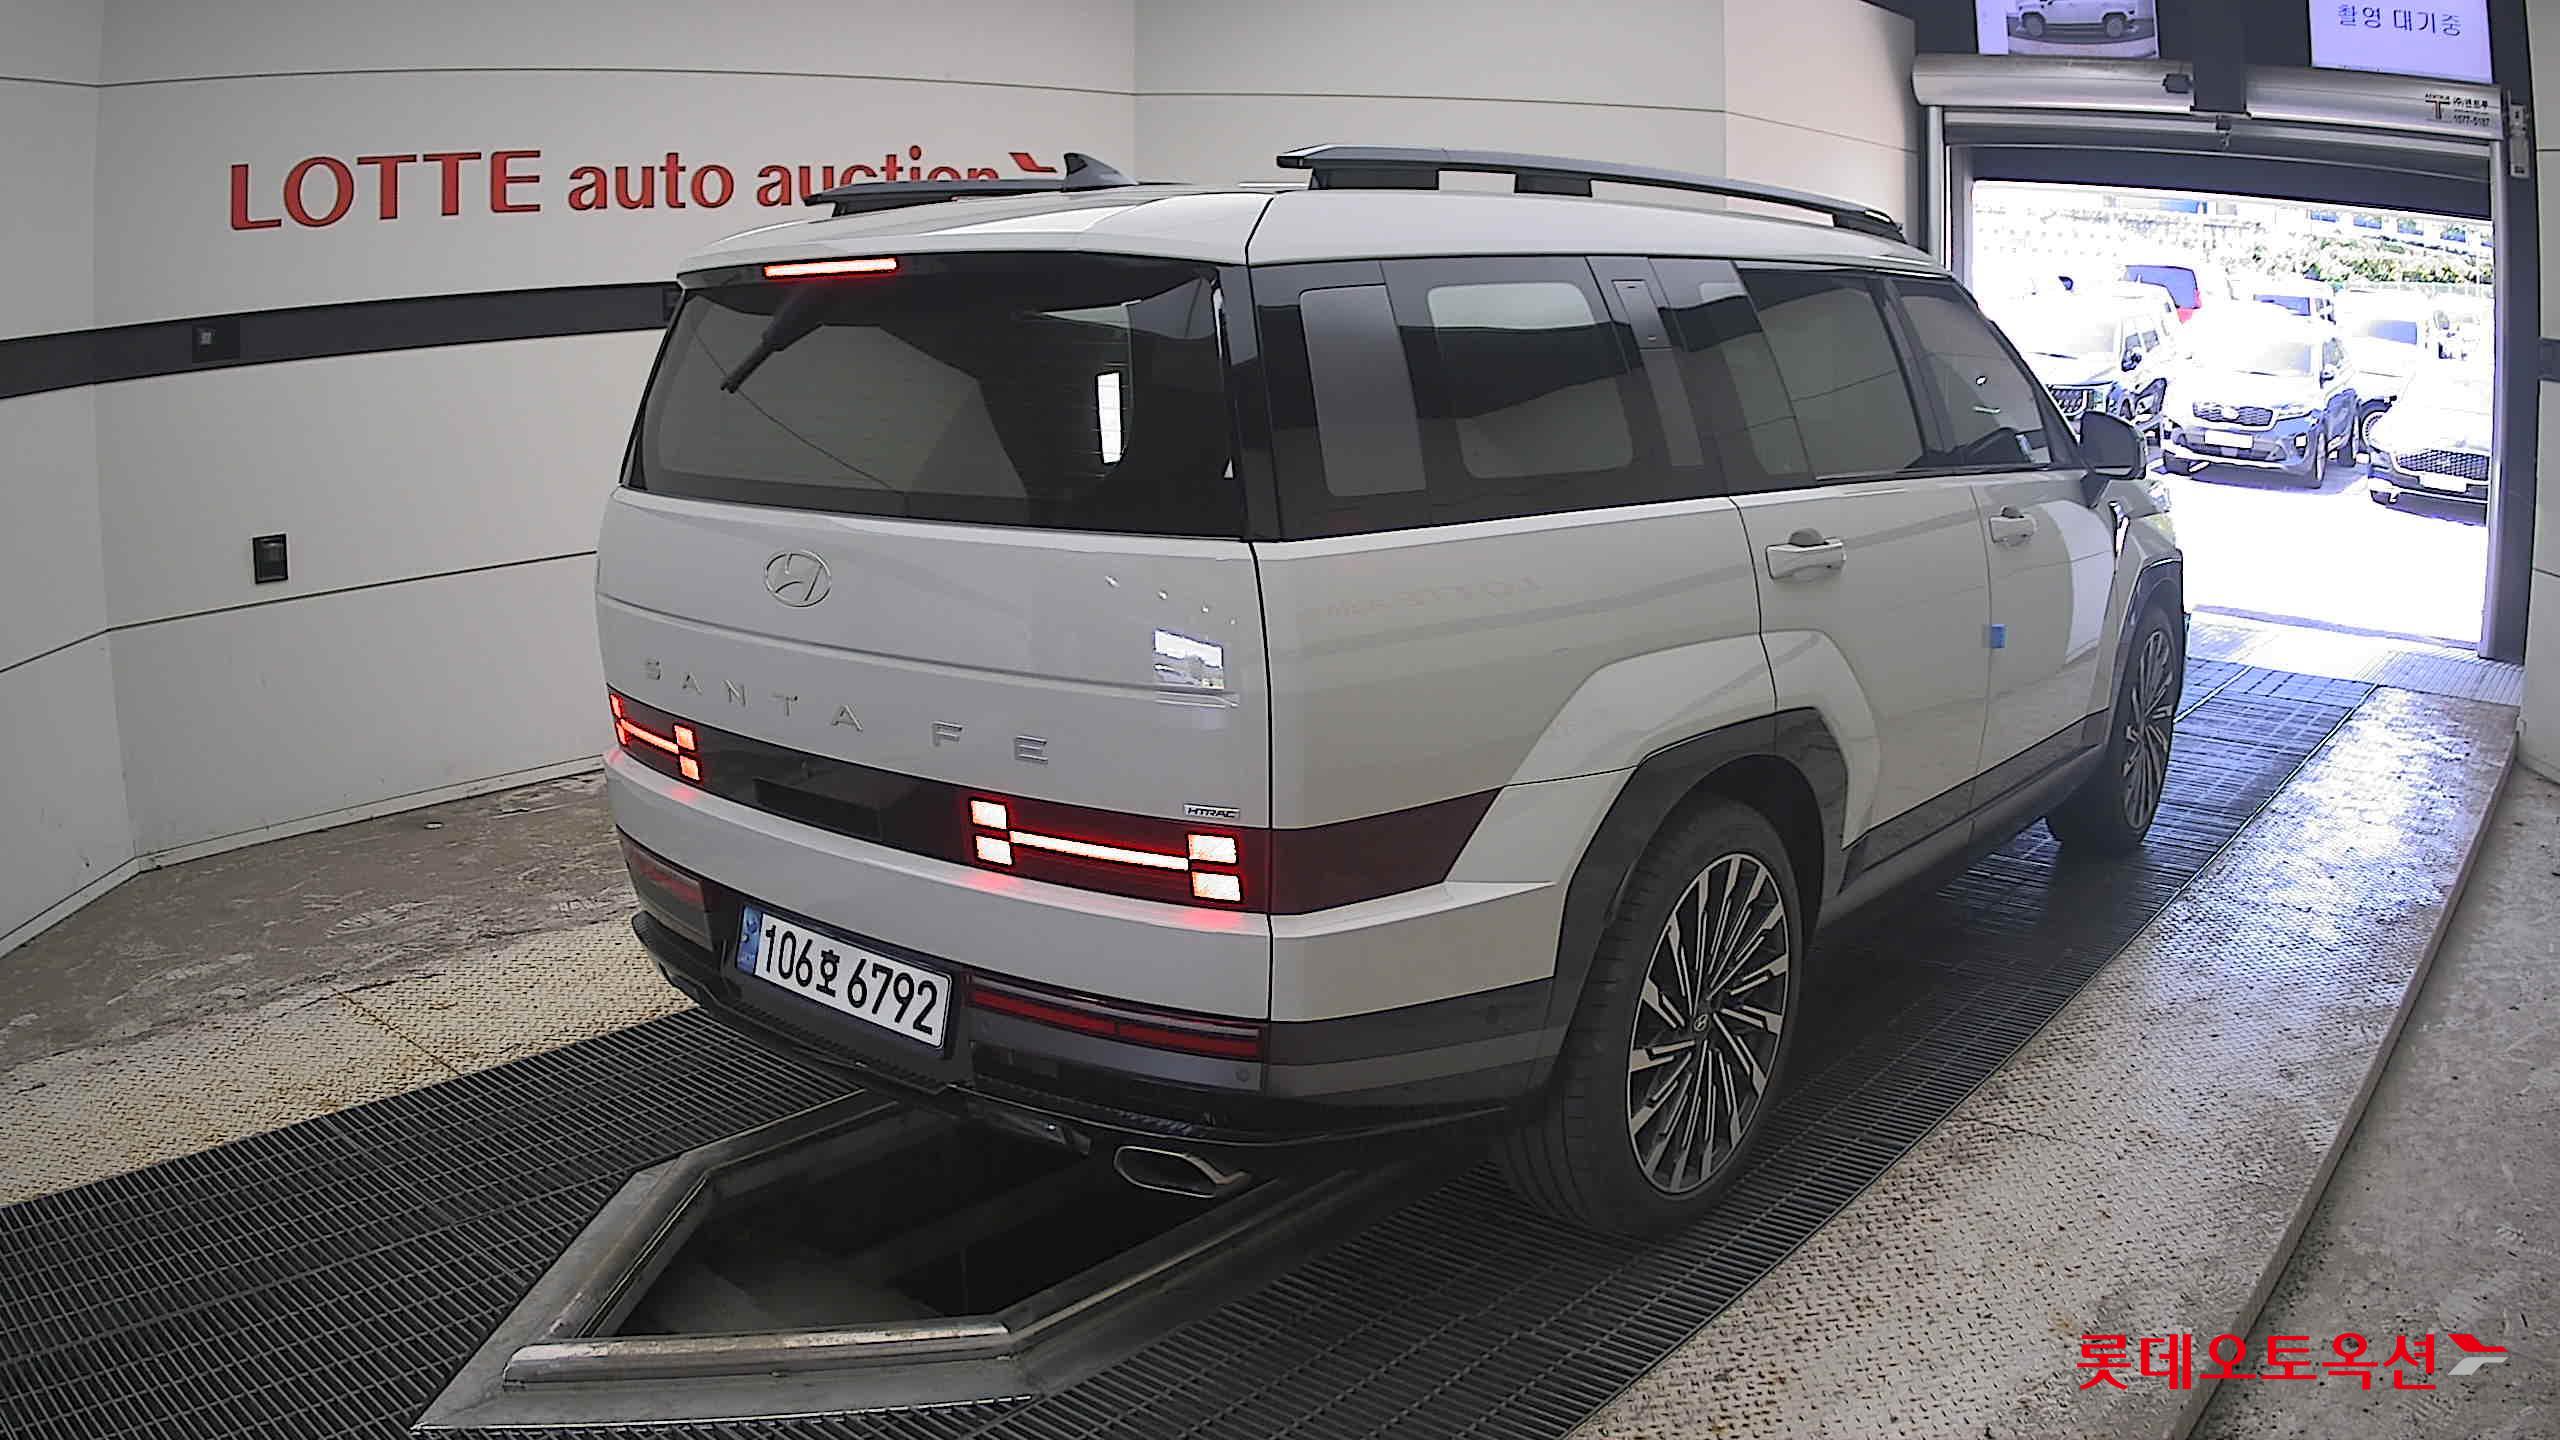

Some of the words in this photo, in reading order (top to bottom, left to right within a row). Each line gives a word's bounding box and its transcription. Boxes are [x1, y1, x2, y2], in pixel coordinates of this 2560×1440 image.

[2393, 8, 2462, 37] 대기중
[230, 149, 541, 230] LOTTE
[567, 152, 736, 210] auto
[646, 656, 864, 733] SANTA
[931, 719, 1049, 765] FE
[1187, 806, 1237, 818] HTRAC
[765, 924, 841, 998] 106호
[847, 957, 939, 1036] 6792
